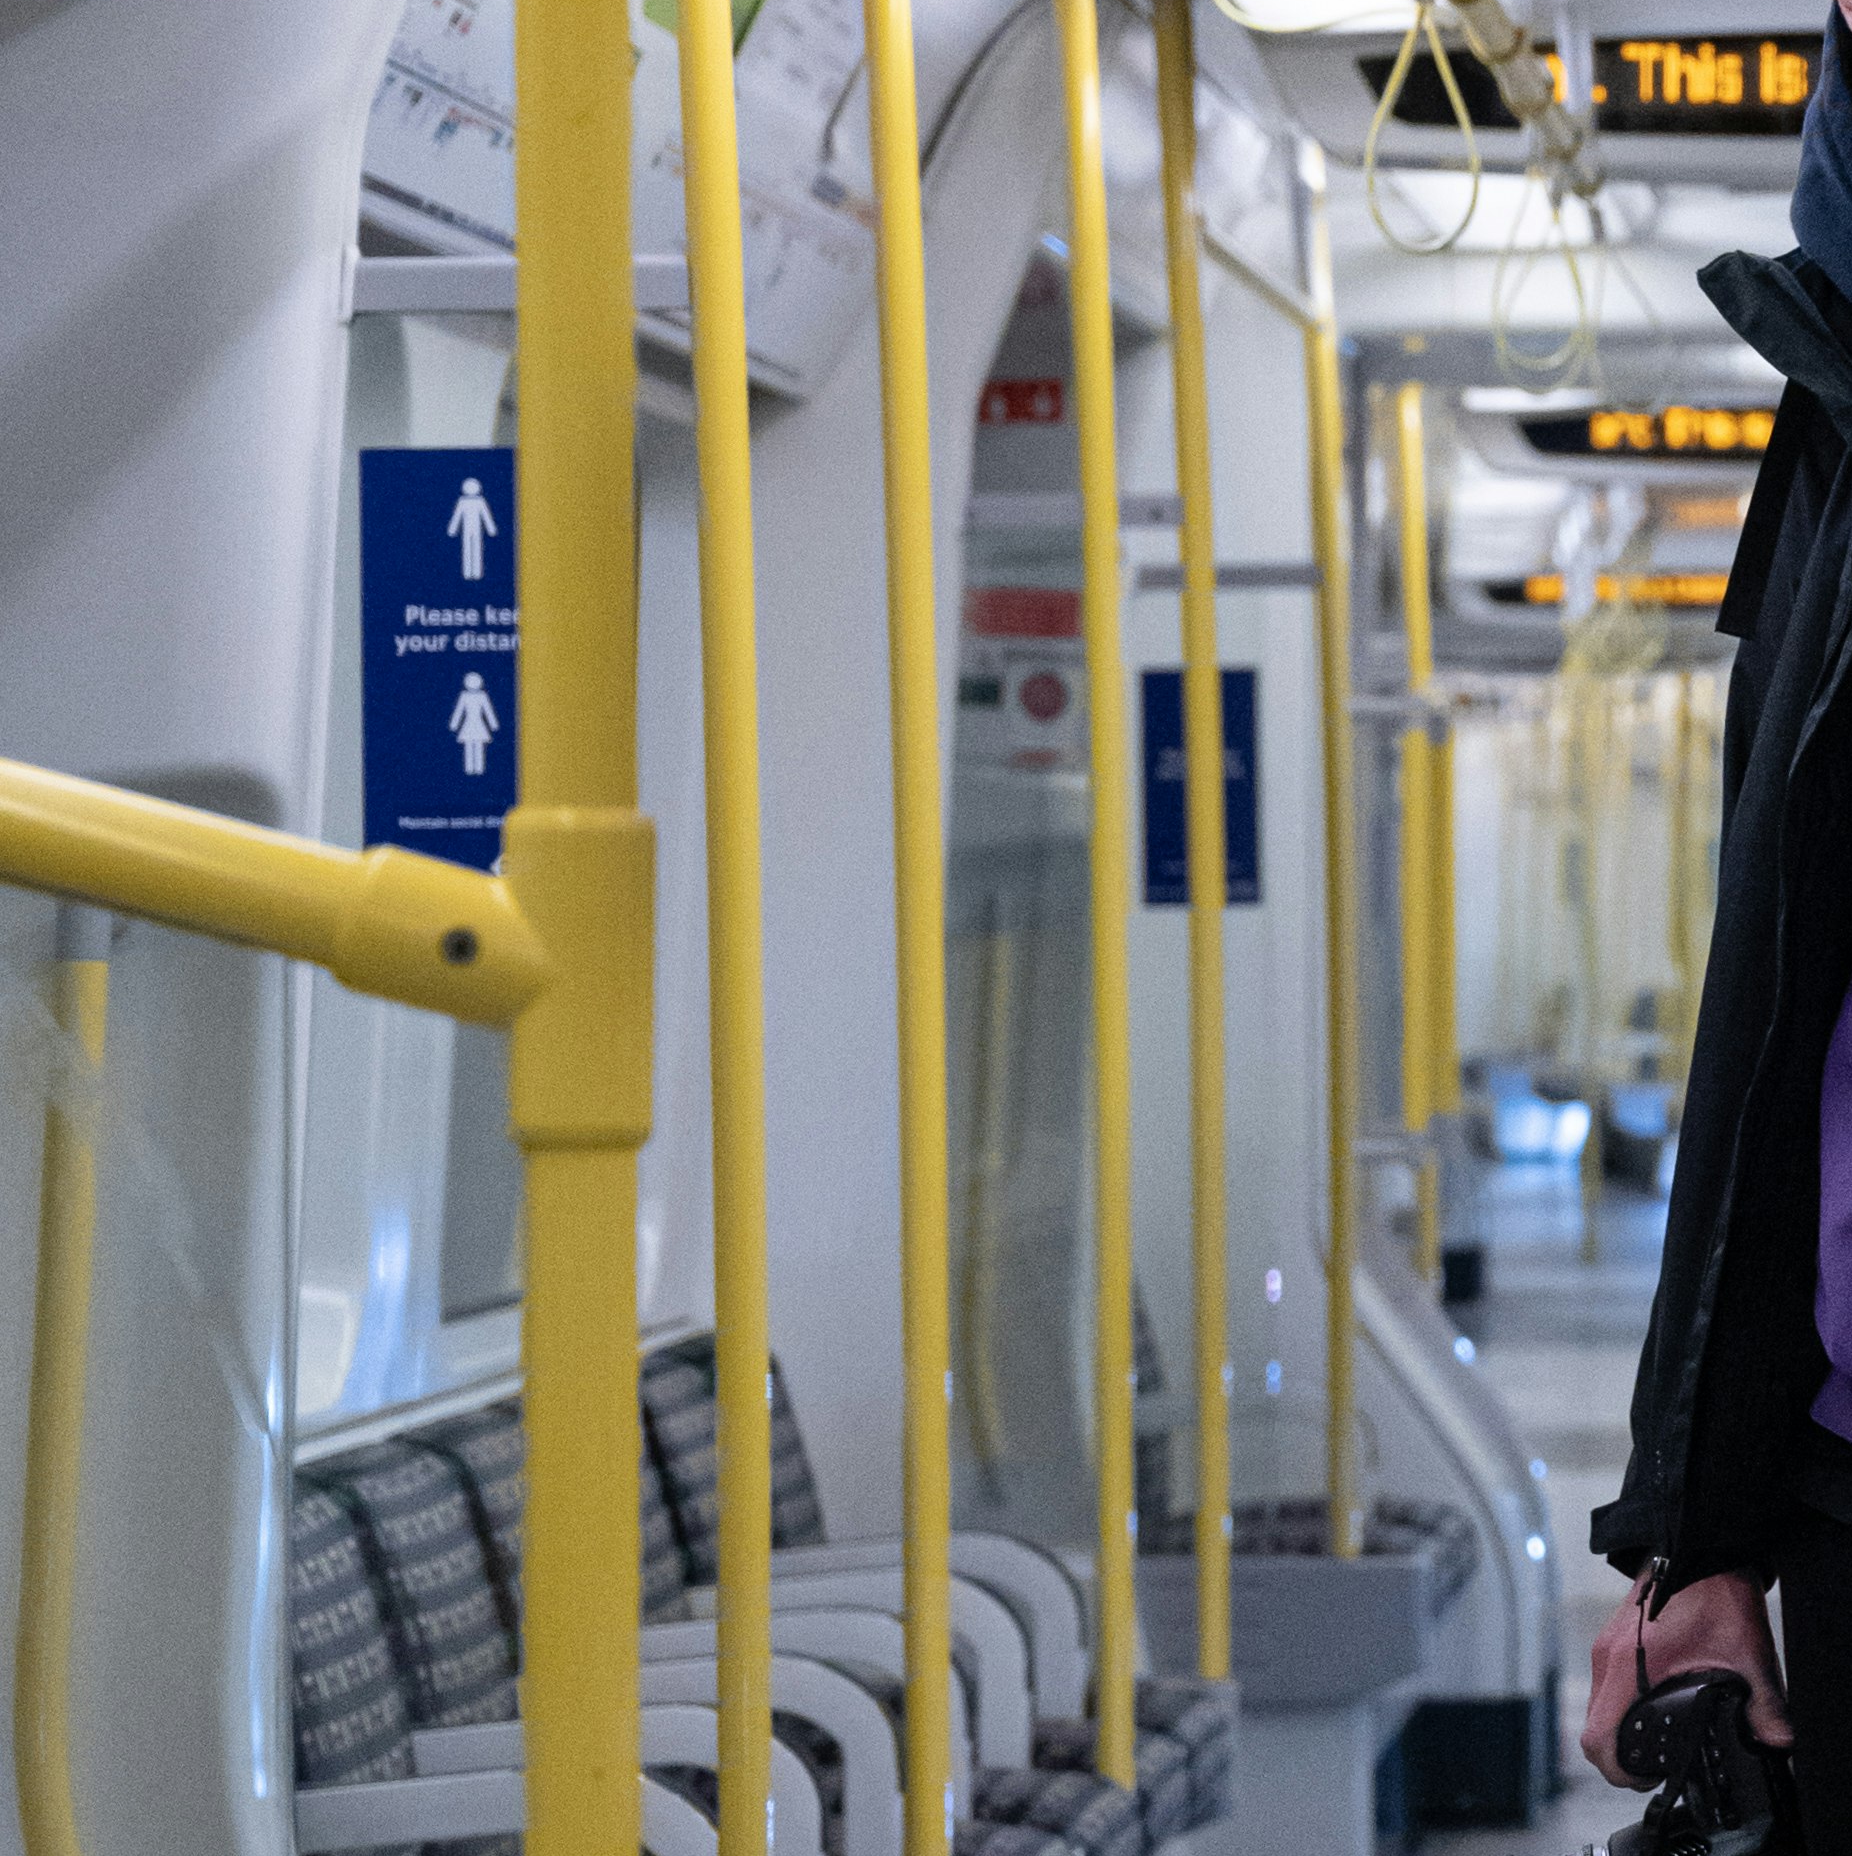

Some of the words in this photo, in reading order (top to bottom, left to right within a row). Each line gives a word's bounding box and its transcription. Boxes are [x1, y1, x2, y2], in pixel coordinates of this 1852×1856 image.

[1620, 41, 1743, 104] This
[1759, 41, 1809, 105] is
[405, 604, 479, 627] Please
[394, 634, 448, 657] your
